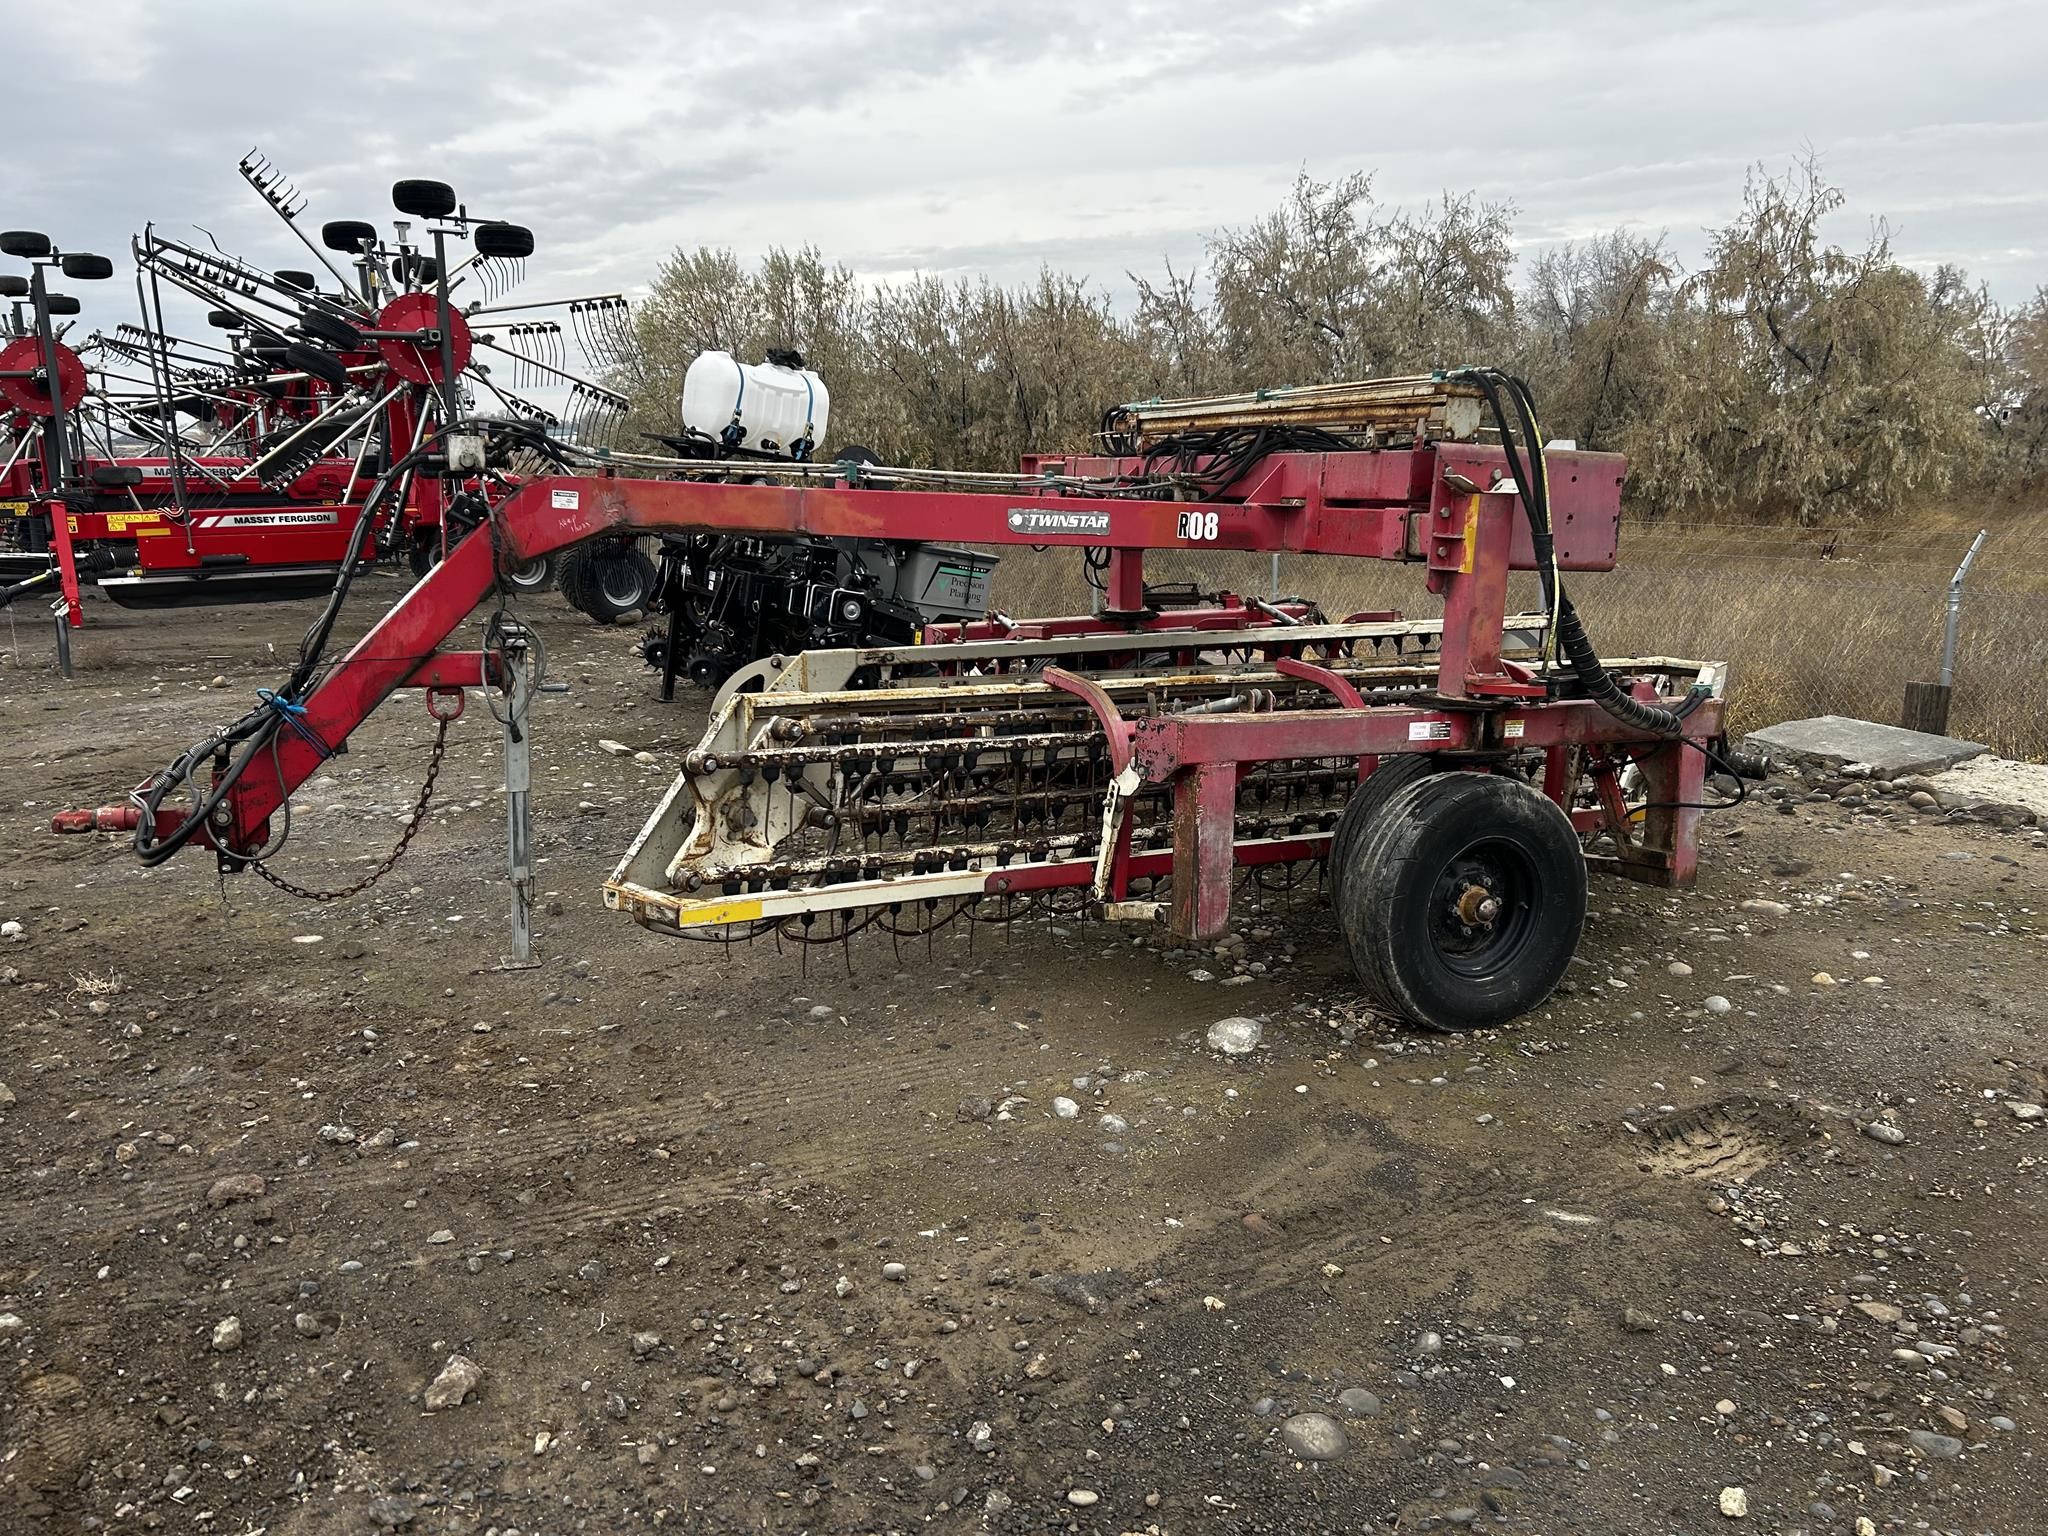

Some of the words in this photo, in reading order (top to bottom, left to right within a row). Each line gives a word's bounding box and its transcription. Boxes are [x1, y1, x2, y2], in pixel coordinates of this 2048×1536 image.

[233, 516, 276, 524] MASSEY
[278, 514, 331, 523] FERGUSON
[1029, 514, 1110, 529] TWINSTAR
[1178, 511, 1219, 541] R08
[951, 576, 985, 590] Precsion
